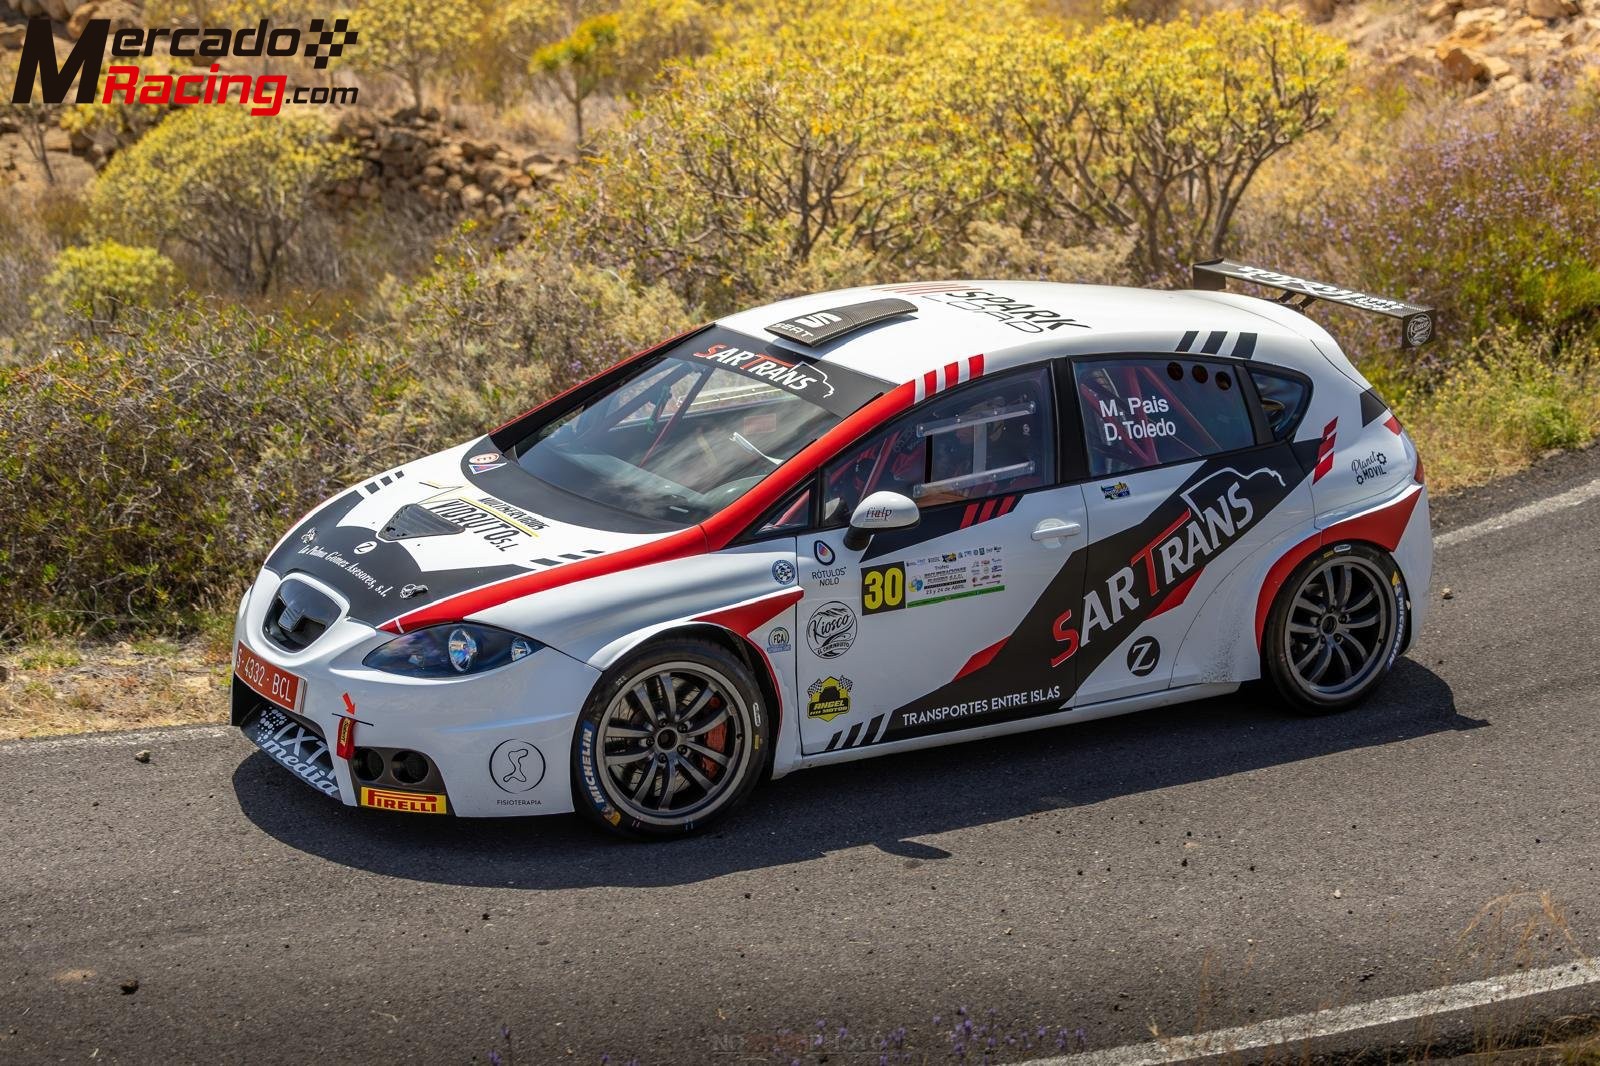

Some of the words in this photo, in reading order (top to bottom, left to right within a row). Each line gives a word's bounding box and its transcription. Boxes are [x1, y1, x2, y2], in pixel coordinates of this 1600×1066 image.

[945, 291, 1092, 331] SPARK
[692, 343, 819, 392] SARTRANS
[1099, 399, 1124, 418] M.
[1127, 395, 1170, 415] Pais
[1104, 422, 1122, 442] D.
[1122, 417, 1177, 440] Toledo
[819, 577, 840, 587] NOLO
[864, 567, 903, 610] 30
[1050, 481, 1254, 668] SARTRANS
[808, 614, 850, 644] Kiosco
[1131, 642, 1156, 673] Z
[902, 700, 989, 726] TRANSPORTES
[990, 692, 1028, 710] ENTRE
[1029, 685, 1061, 703] ISLAS
[261, 739, 340, 796] media
[367, 789, 437, 813] PIRELLI
